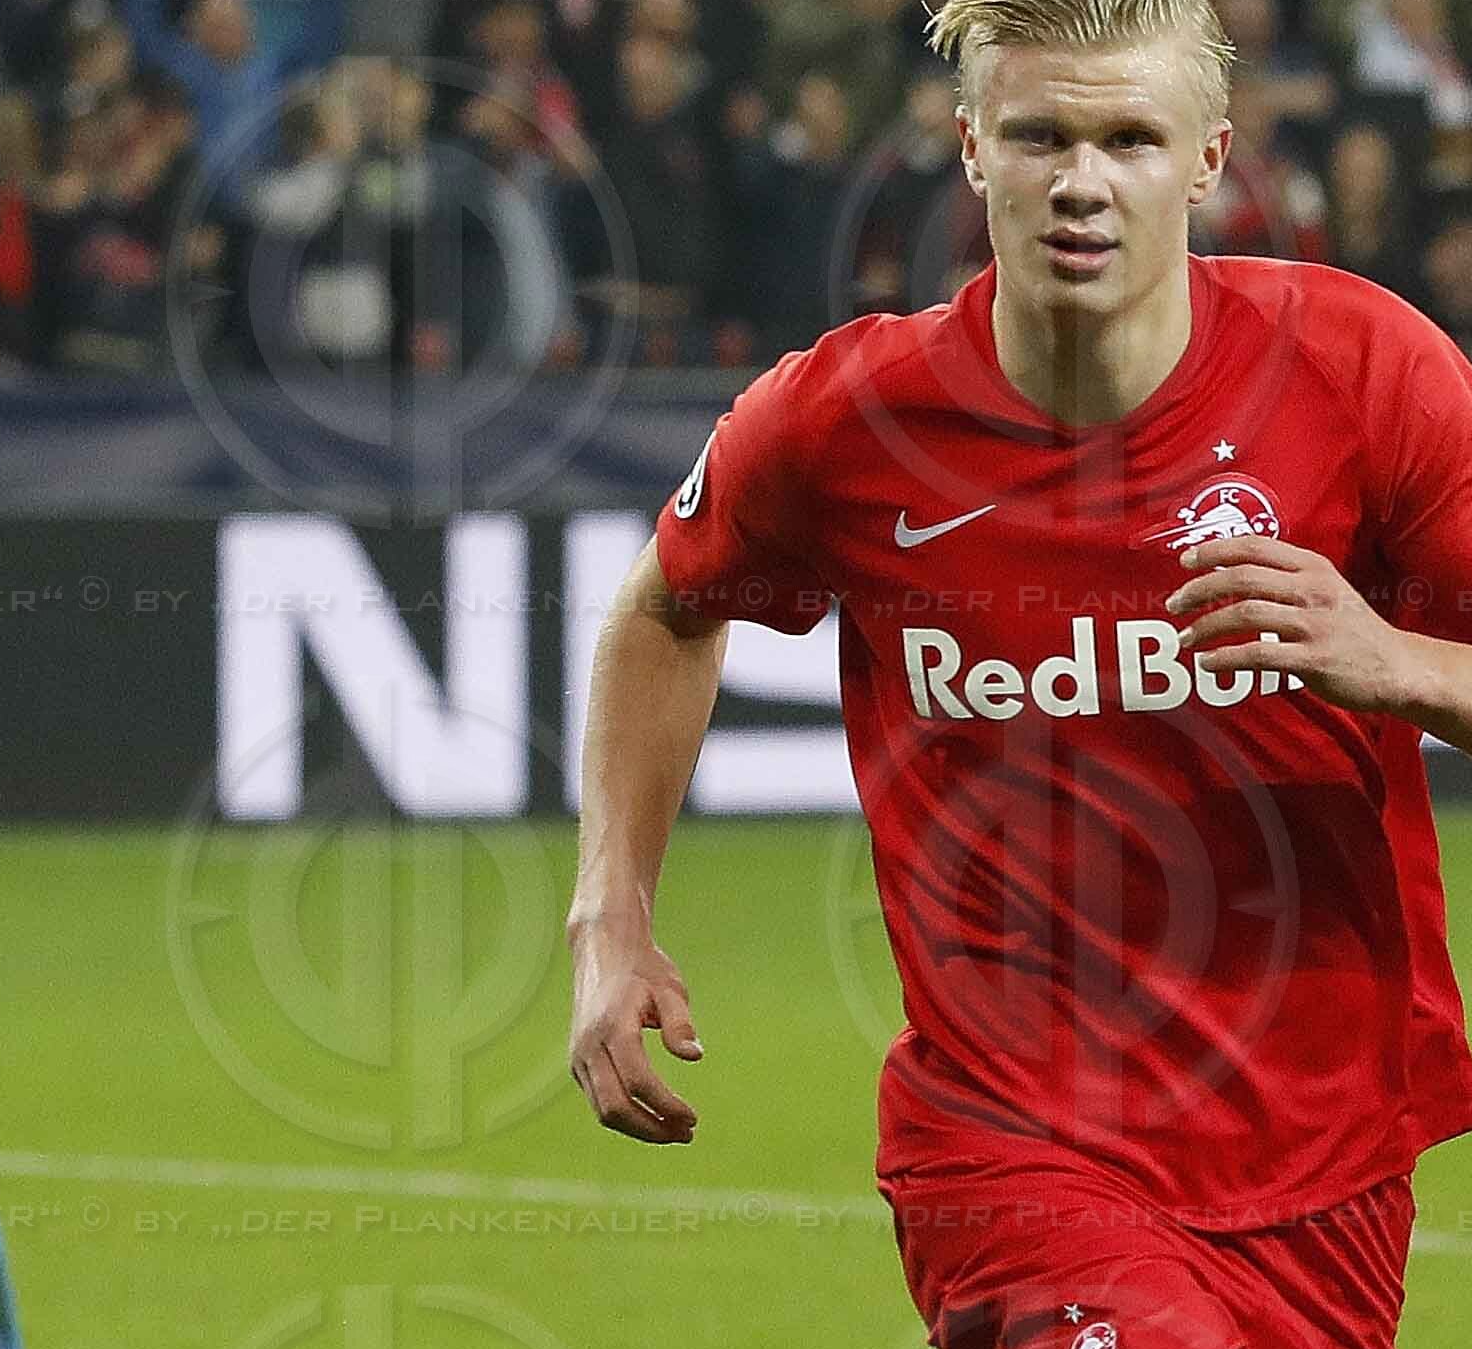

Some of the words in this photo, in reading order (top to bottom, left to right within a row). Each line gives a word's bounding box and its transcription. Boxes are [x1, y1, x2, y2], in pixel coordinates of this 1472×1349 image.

[1219, 488, 1240, 504] FC
[902, 616, 1100, 720] Red
[1116, 619, 1305, 712] Bu
